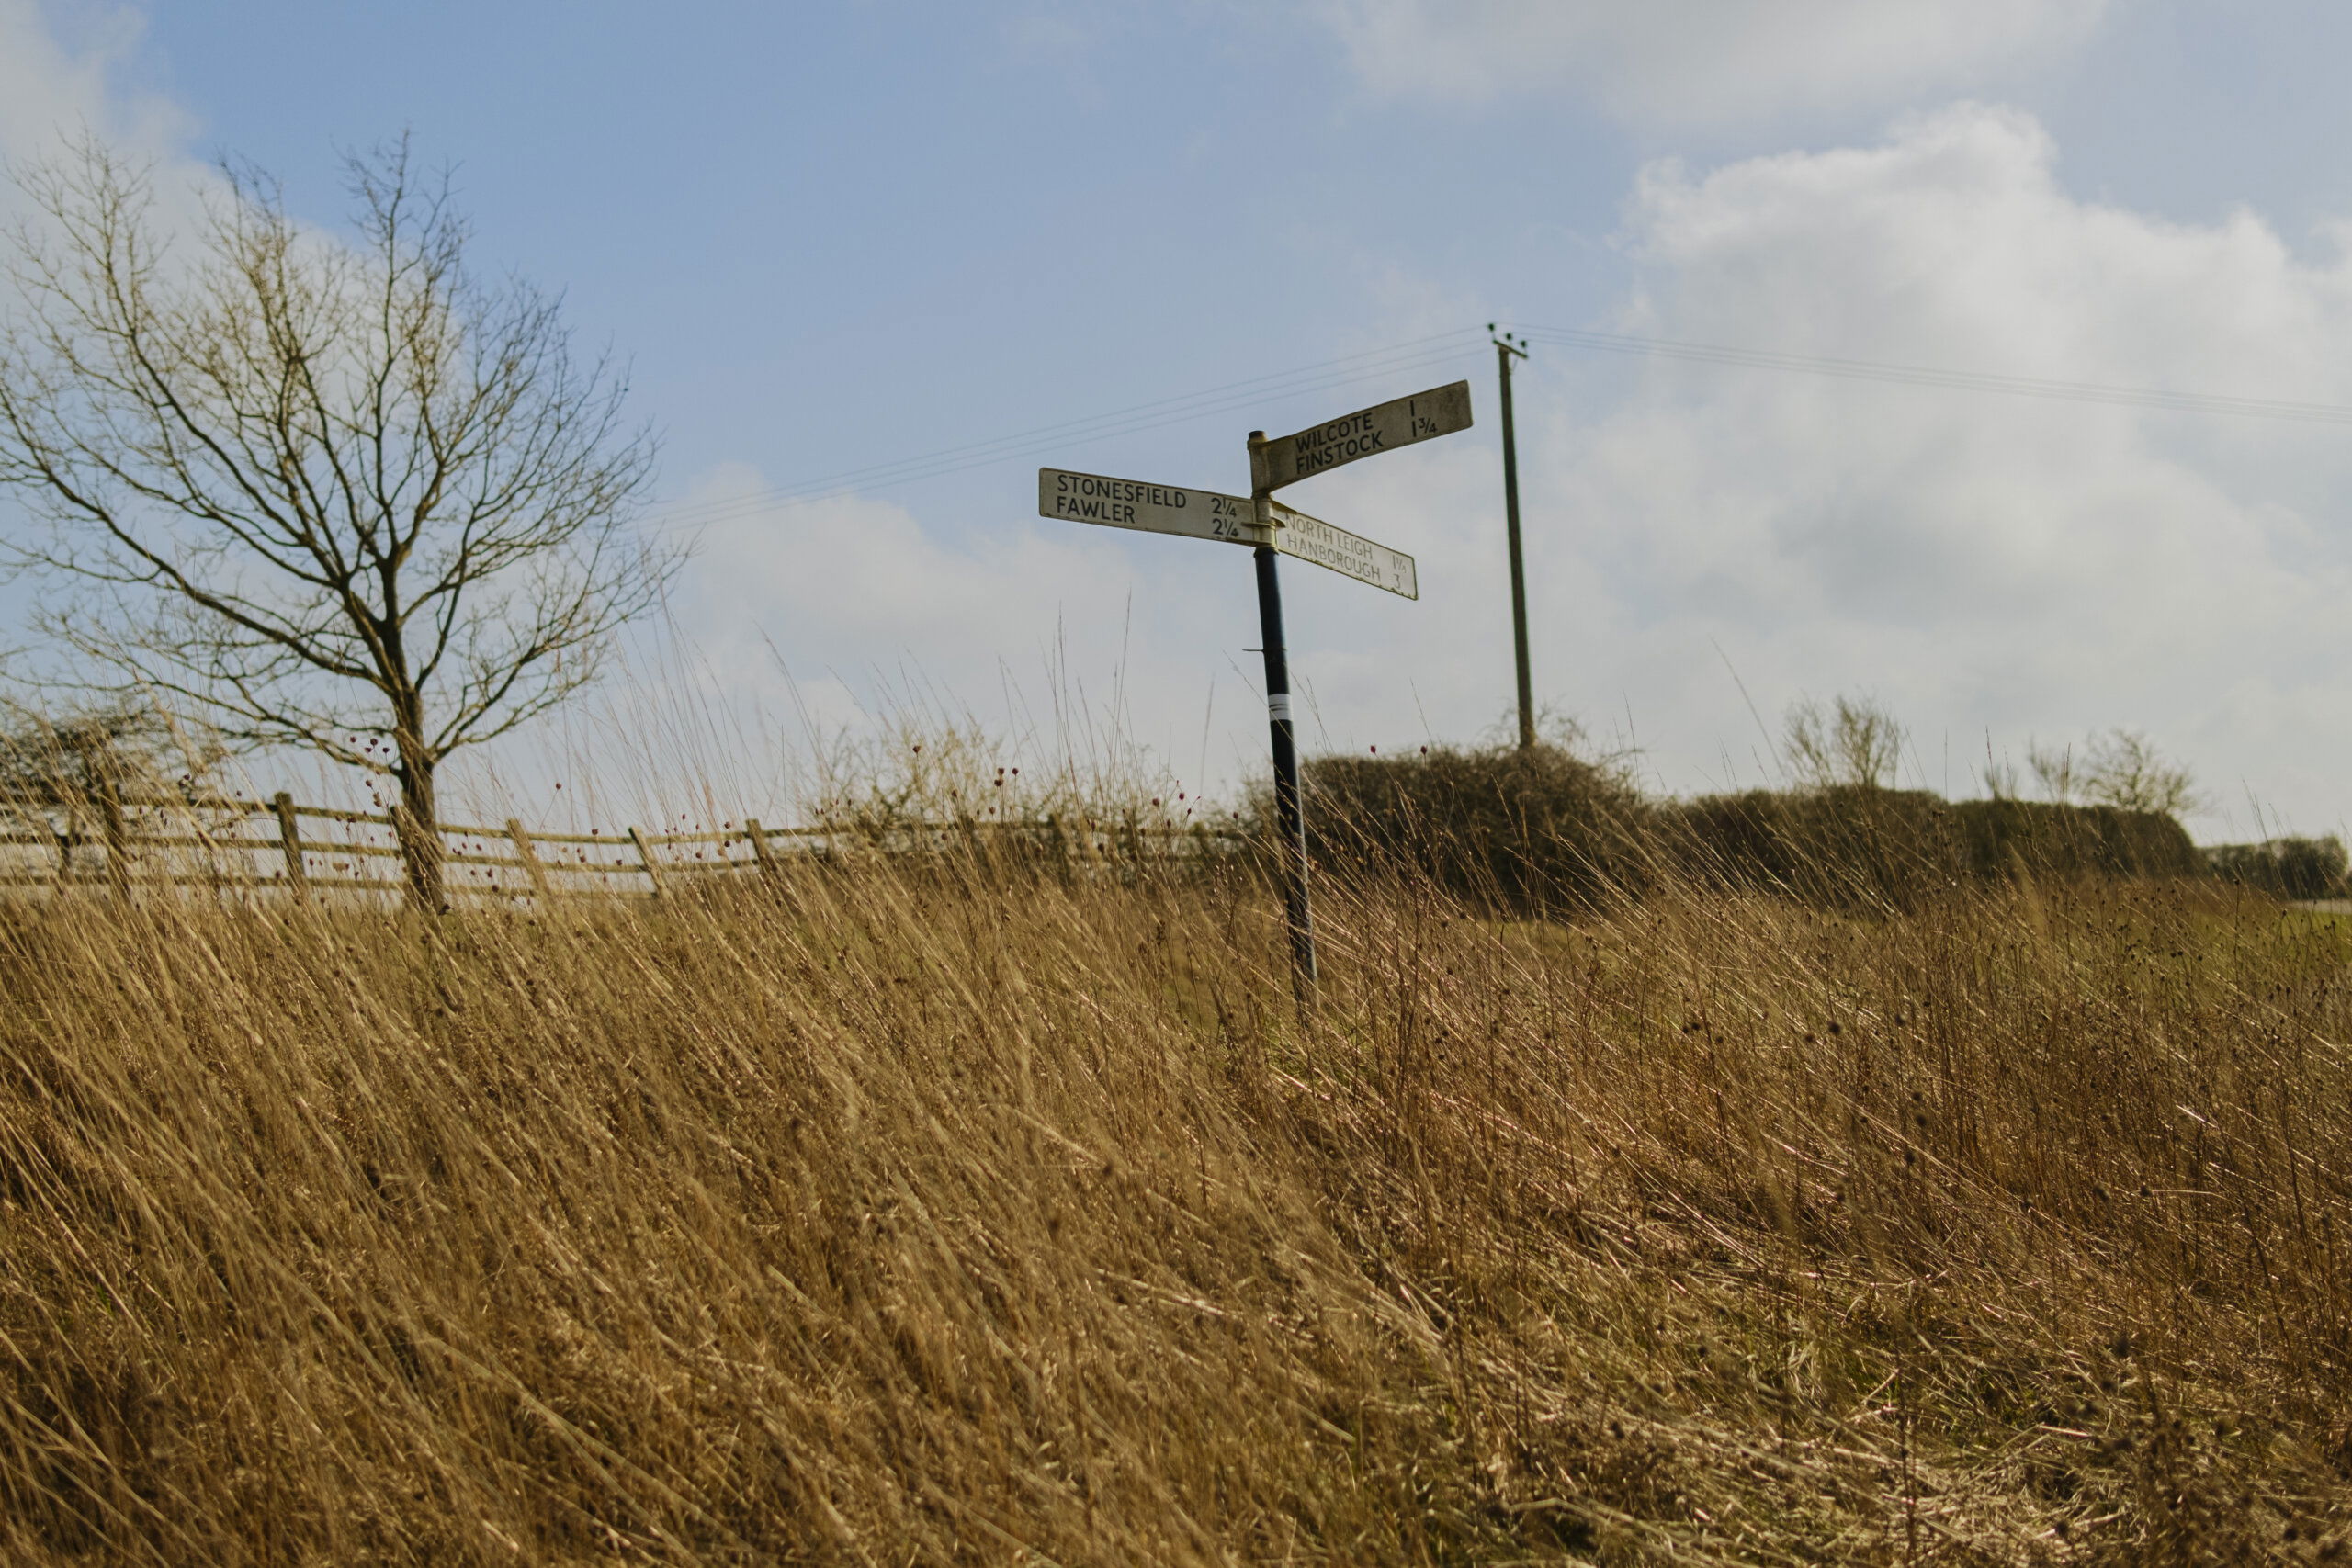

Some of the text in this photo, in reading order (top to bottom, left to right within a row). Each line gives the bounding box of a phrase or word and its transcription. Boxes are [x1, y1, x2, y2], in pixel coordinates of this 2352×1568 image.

[1295, 412, 1374, 453] WILCOTE
[1296, 431, 1384, 474] FINSTOCK
[1057, 474, 1187, 509] STONESFIELD
[1057, 496, 1136, 524] FAWLER
[1286, 513, 1333, 545] NORTH
[1337, 533, 1374, 560] LEIGH
[1287, 534, 1381, 582] HANBOROUGH
